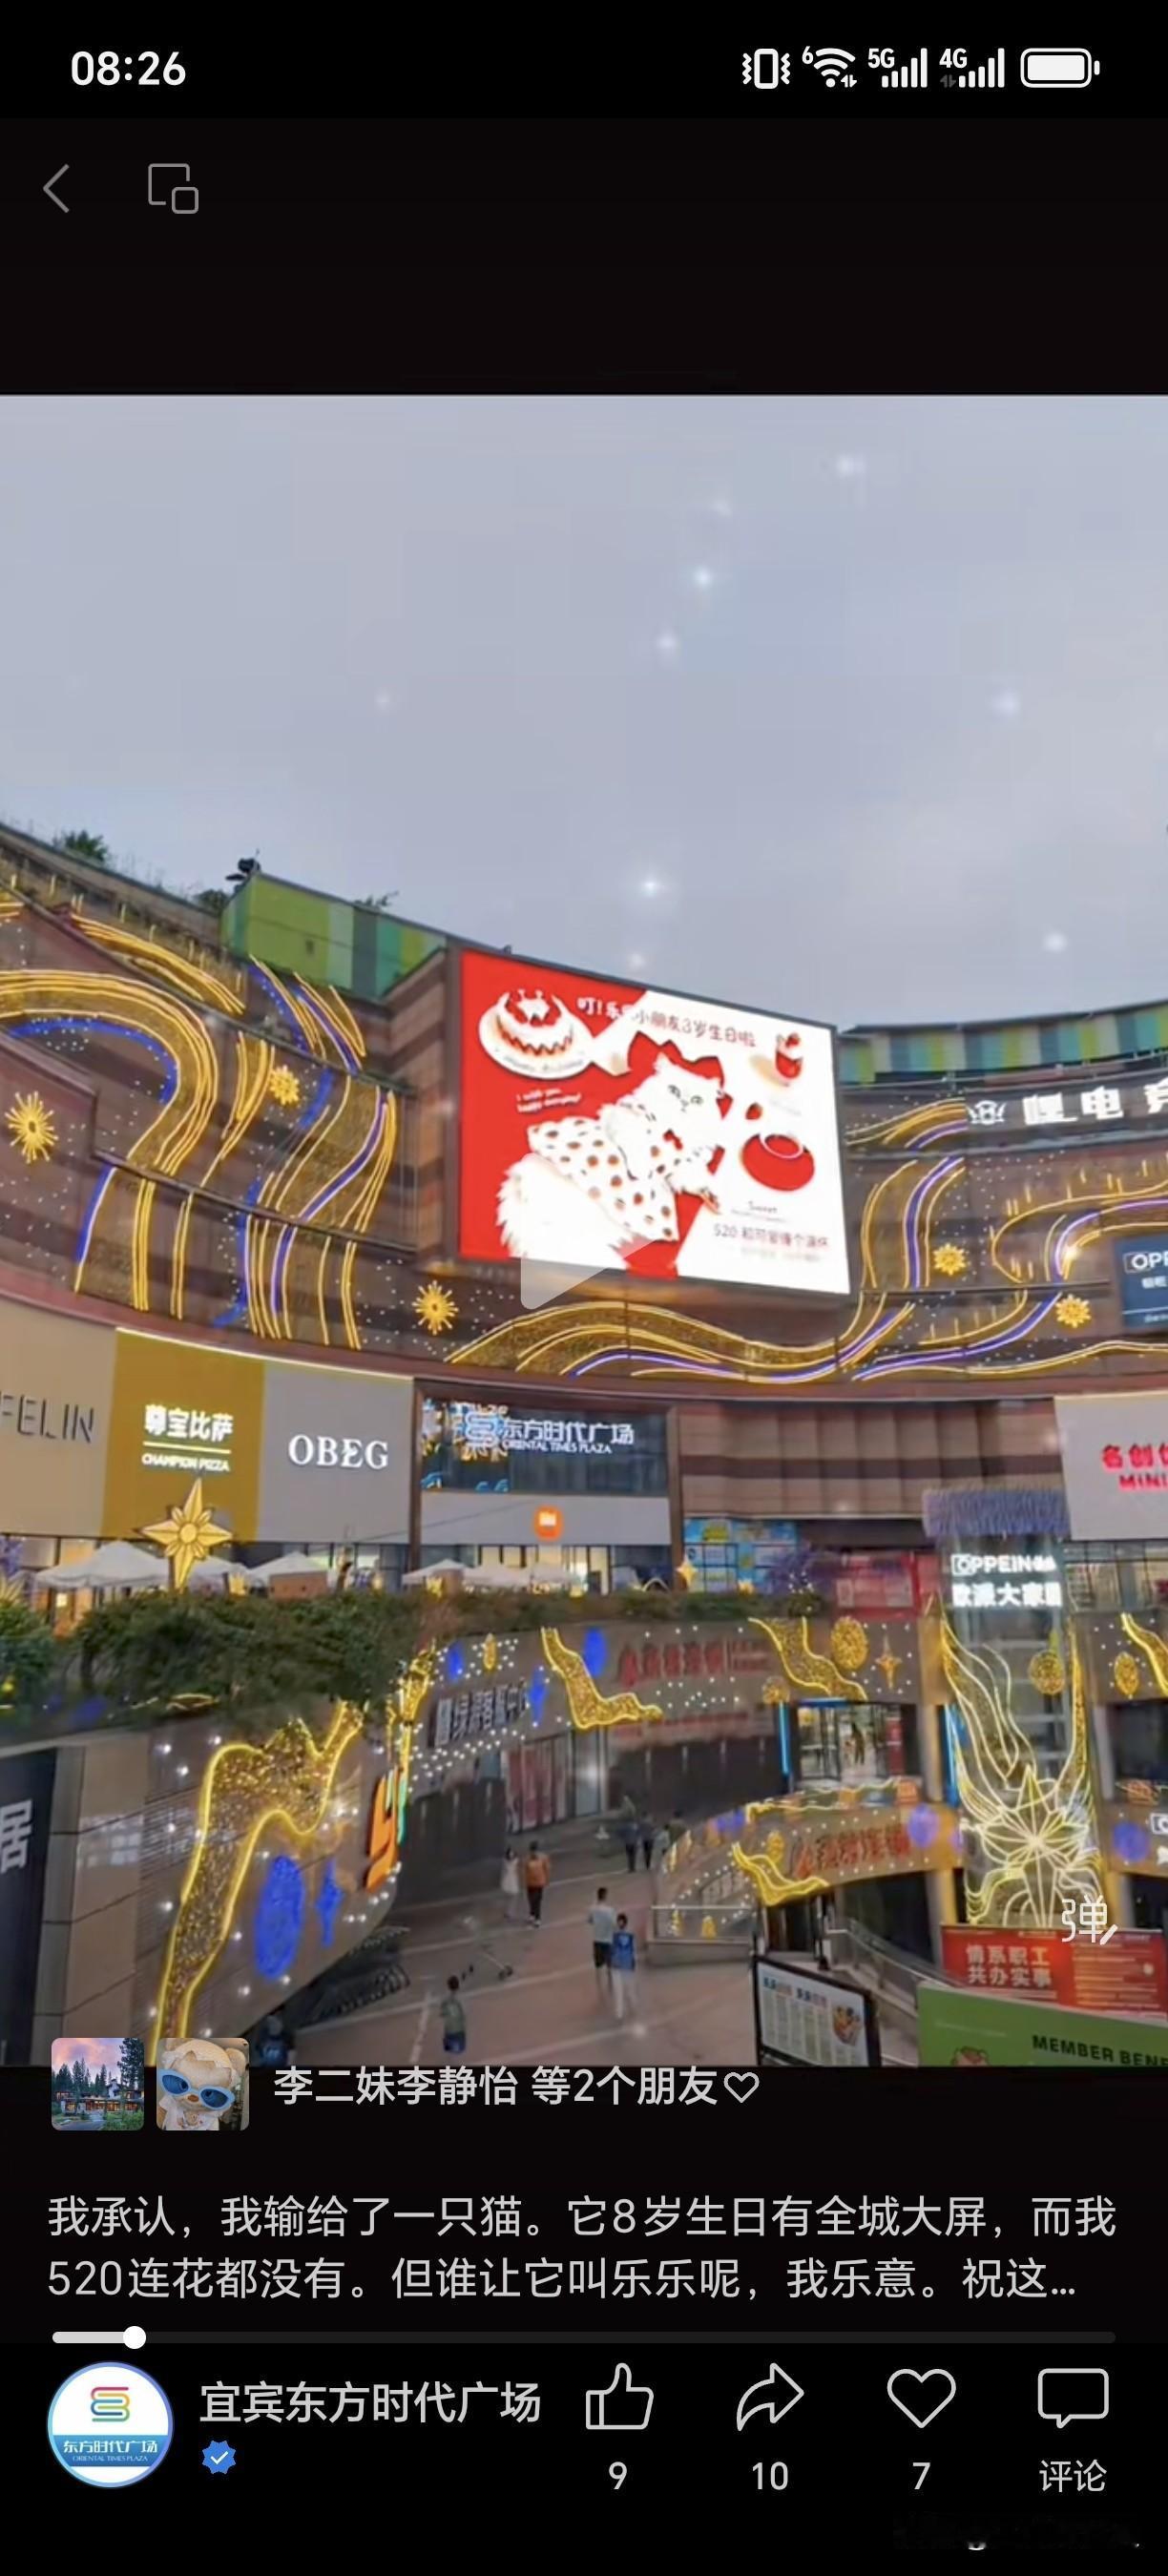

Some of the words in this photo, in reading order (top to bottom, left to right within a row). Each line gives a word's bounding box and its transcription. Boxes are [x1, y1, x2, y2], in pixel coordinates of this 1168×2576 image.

[145, 1404, 233, 1442] 尊宝比萨
[504, 1417, 634, 1444] 东方时代广场
[550, 1441, 577, 1452] TIMES
[578, 1443, 612, 1454] PLAZA
[141, 1453, 197, 1469] CHAMPION
[198, 1458, 230, 1471] PIZZA
[1032, 2034, 1114, 2063] MEMBER
